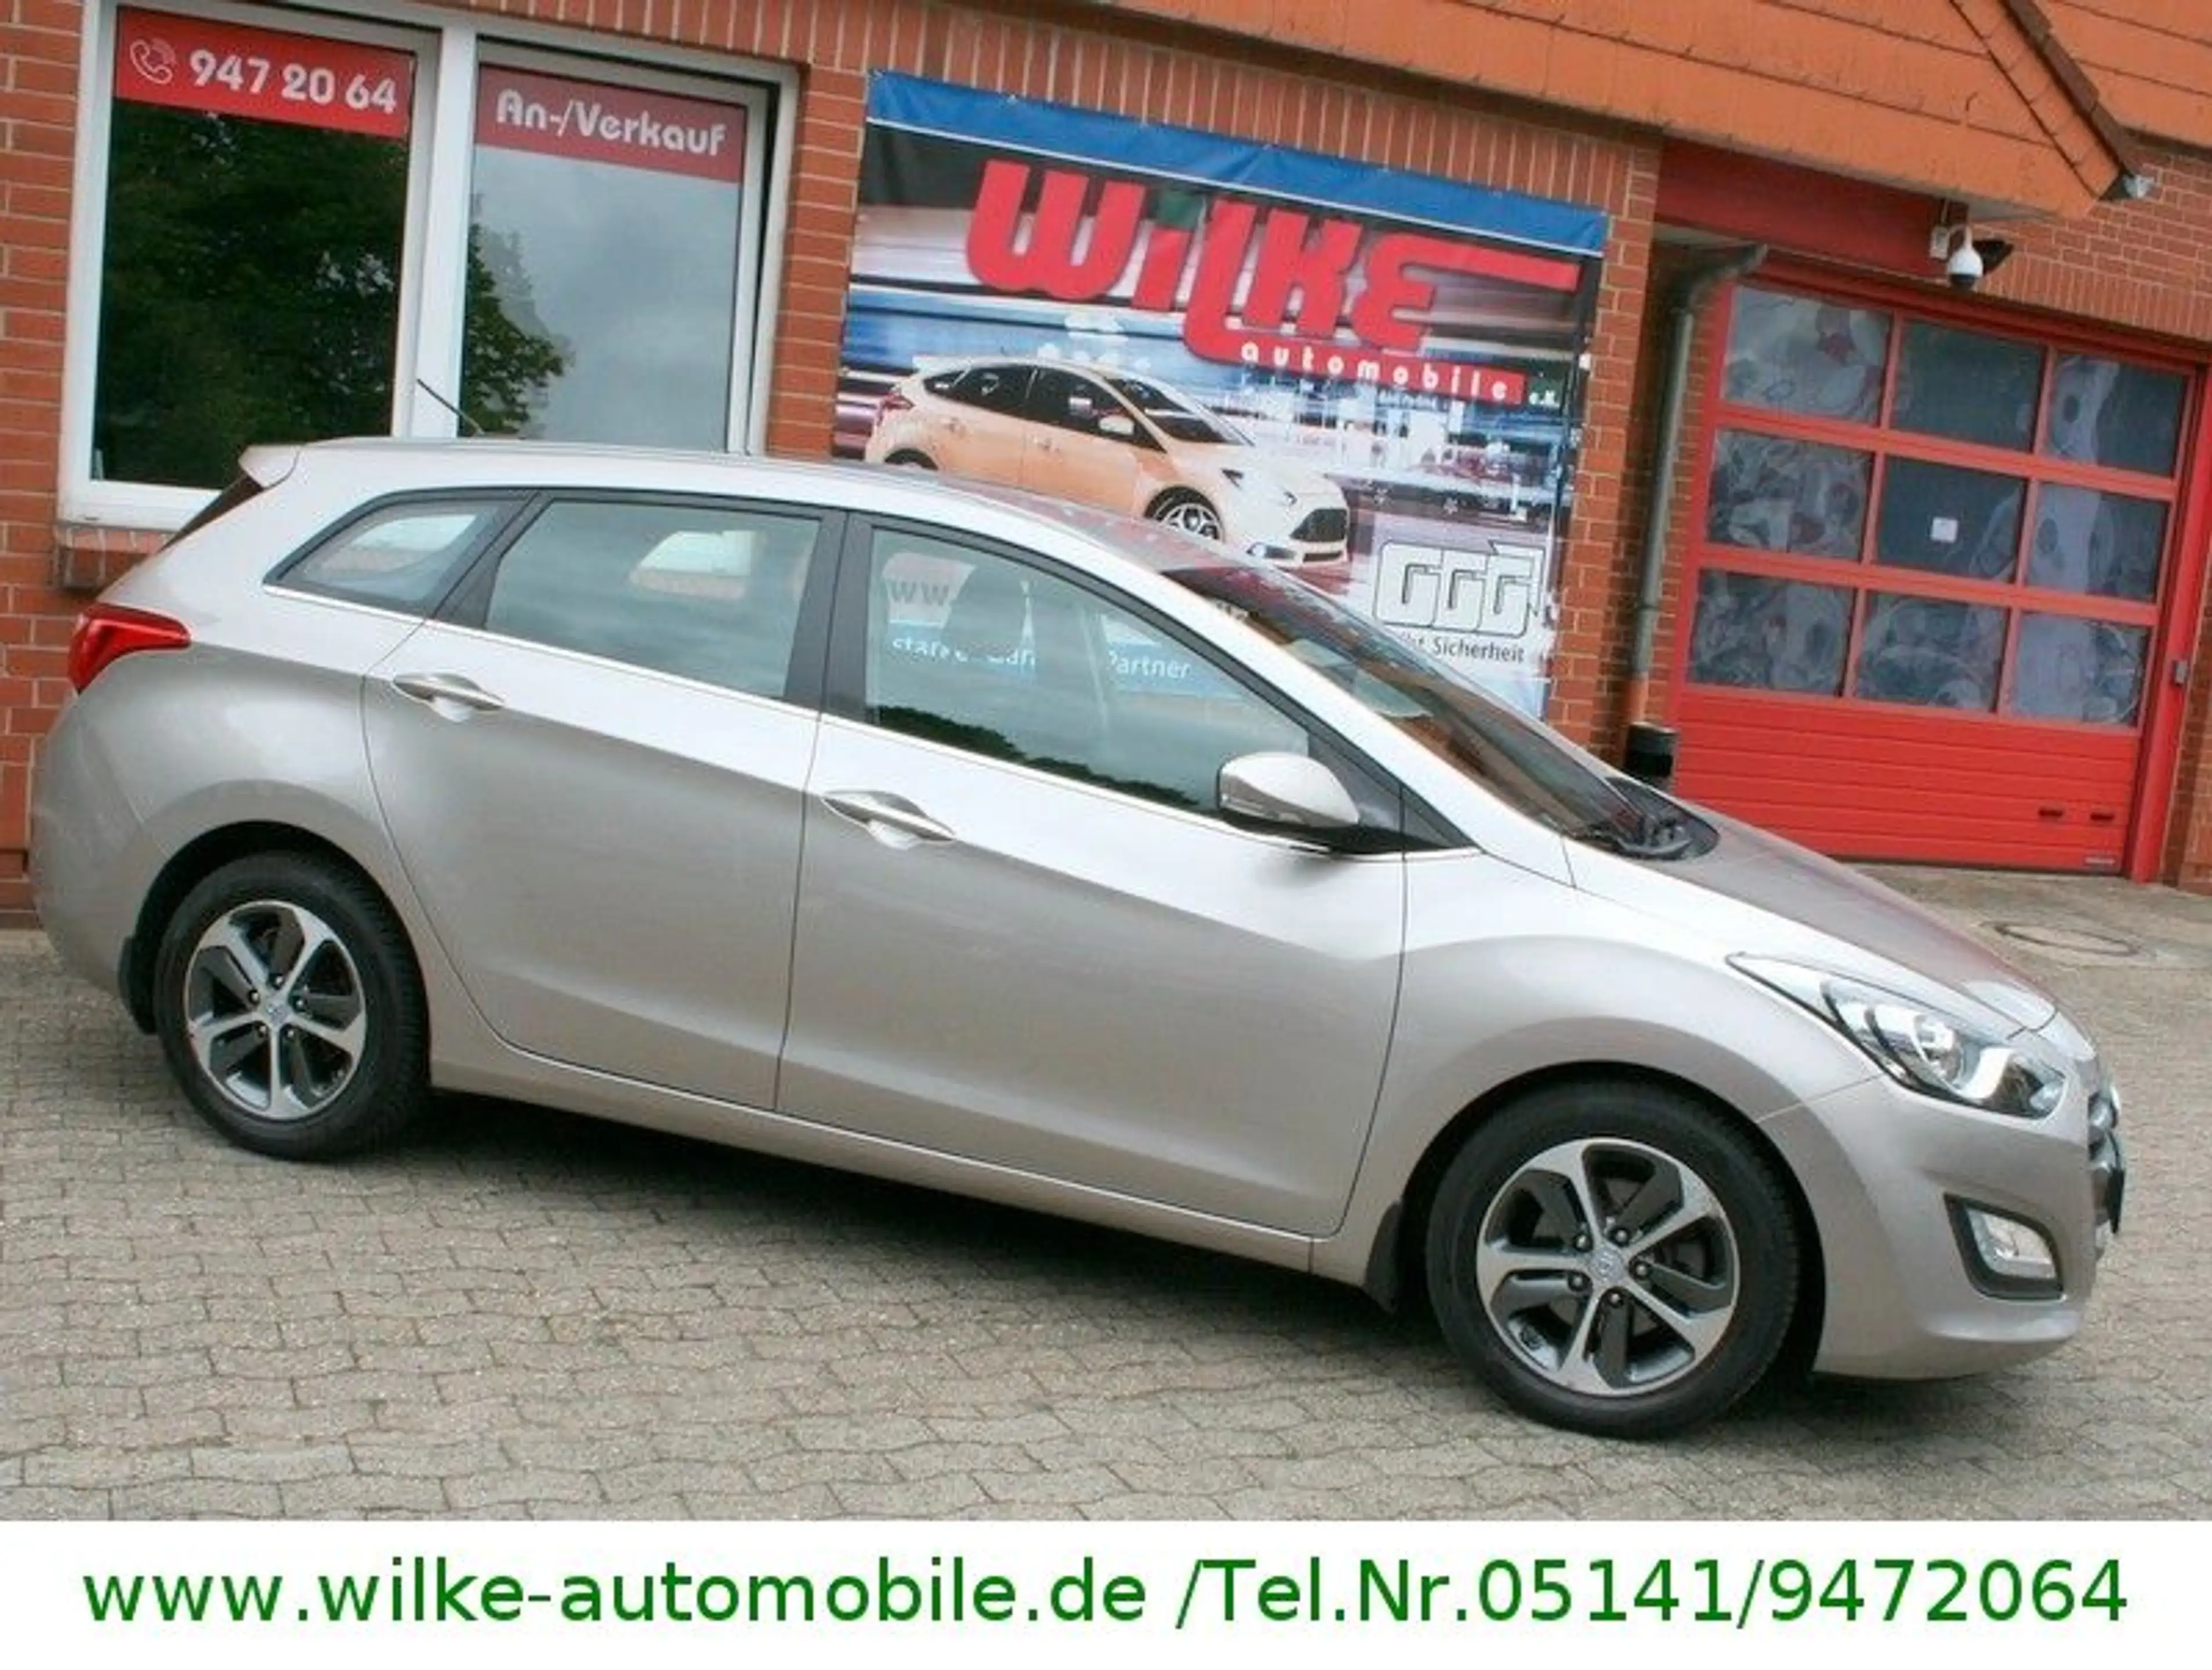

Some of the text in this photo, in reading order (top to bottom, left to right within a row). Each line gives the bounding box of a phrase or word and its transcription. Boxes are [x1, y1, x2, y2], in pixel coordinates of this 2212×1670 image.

[190, 49, 397, 115] 947 20 64
[496, 88, 727, 157] An-/Verkauf
[1241, 340, 1508, 401] automobile
[1433, 636, 1525, 663] Sicherheit
